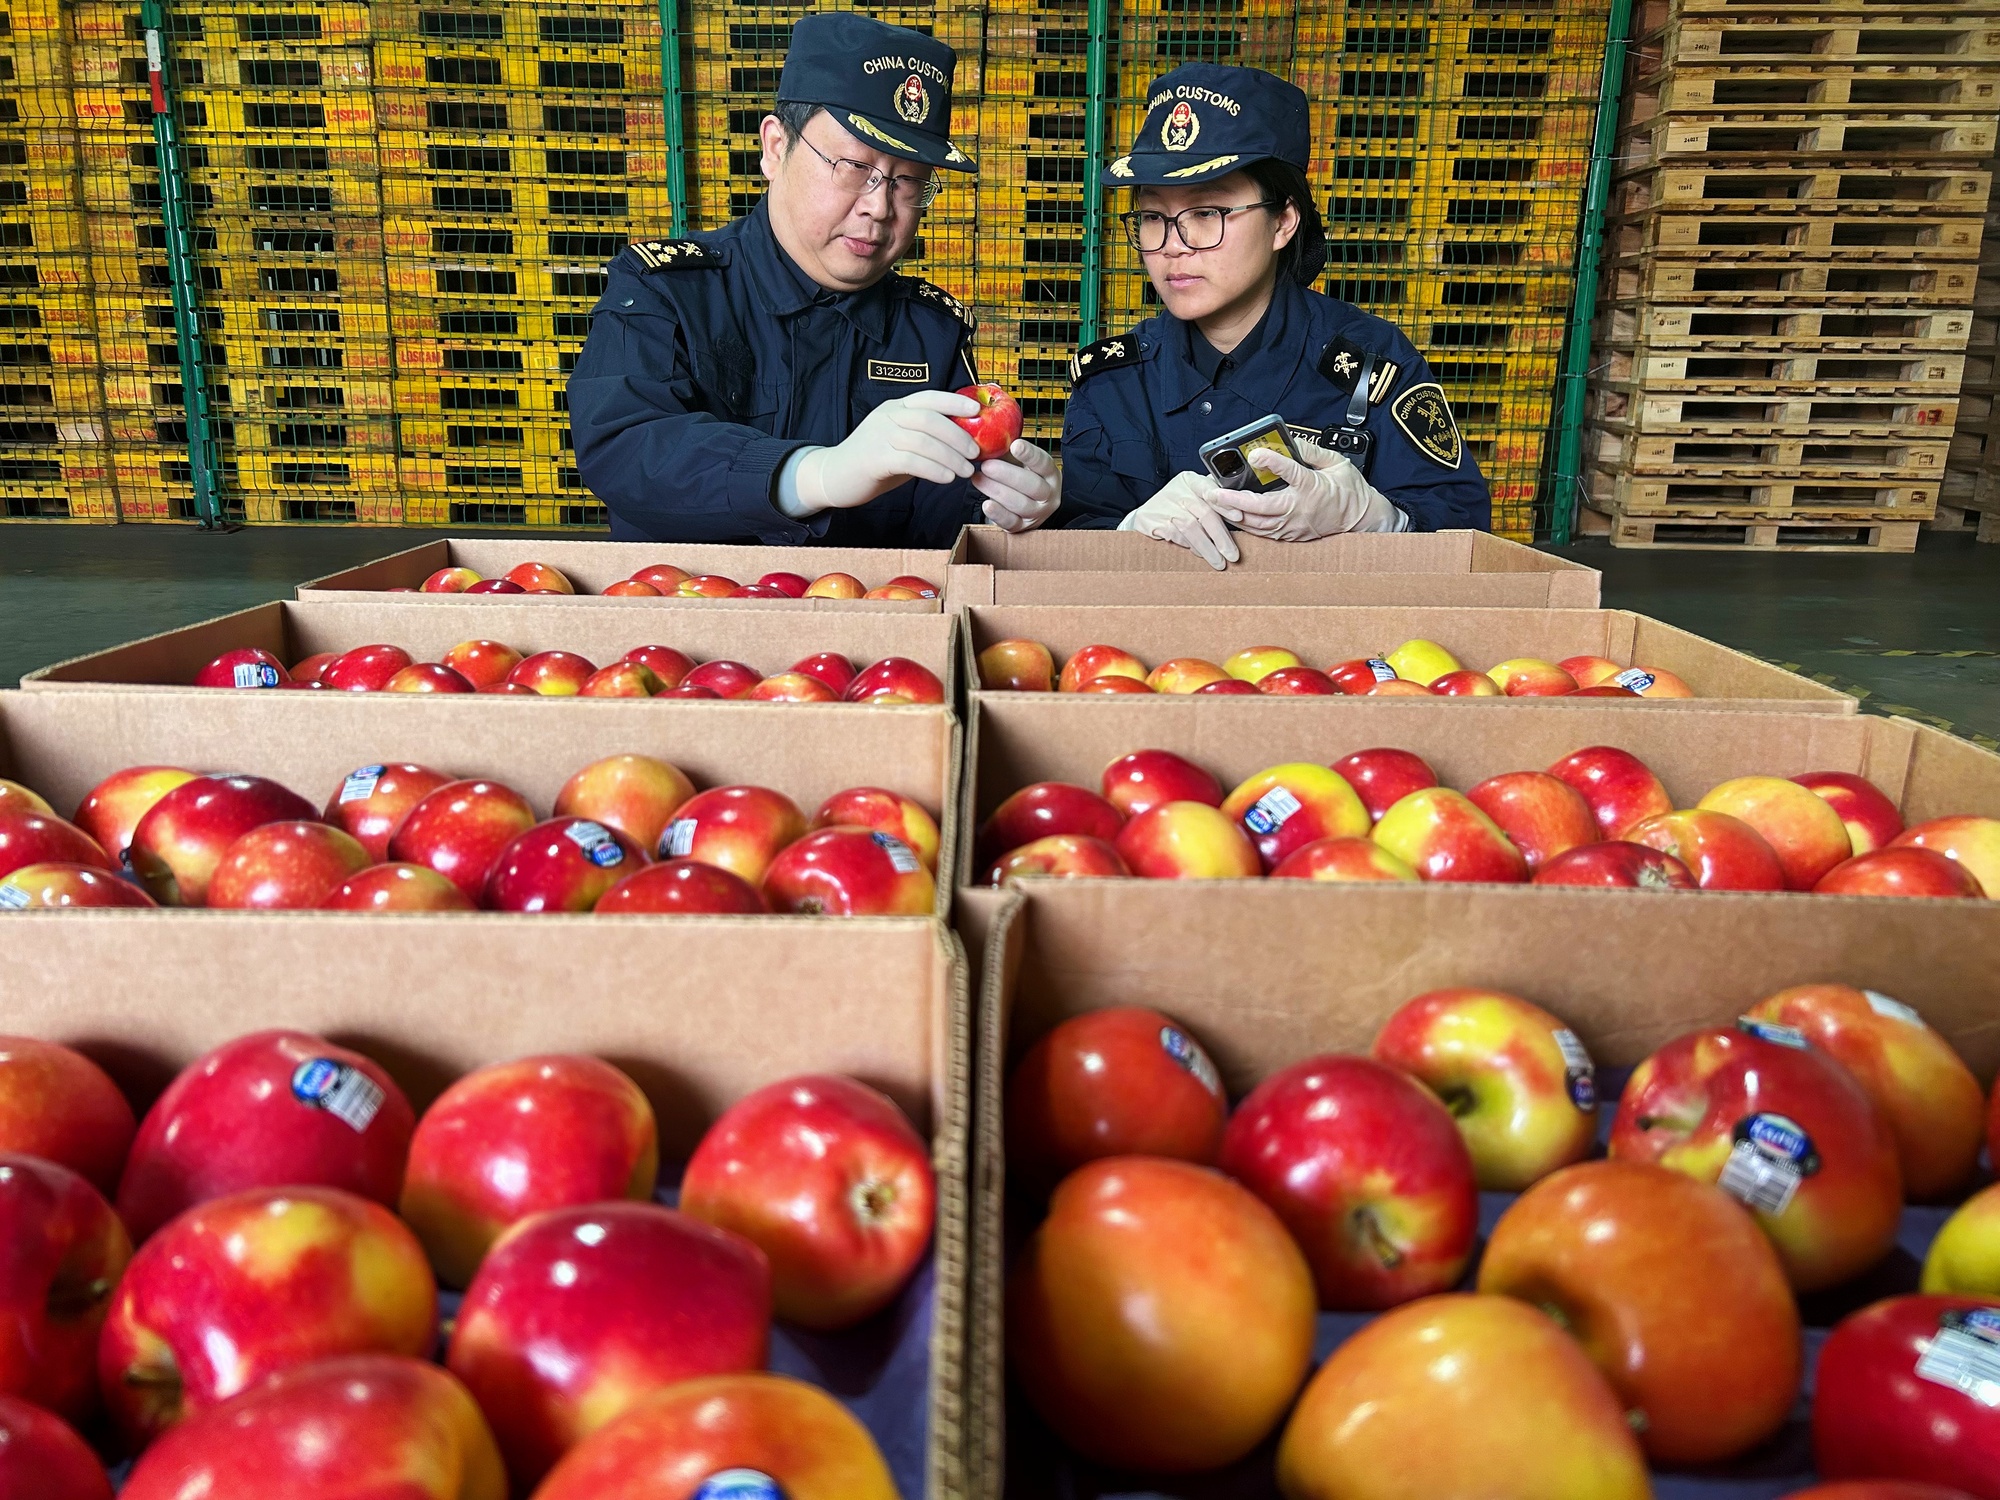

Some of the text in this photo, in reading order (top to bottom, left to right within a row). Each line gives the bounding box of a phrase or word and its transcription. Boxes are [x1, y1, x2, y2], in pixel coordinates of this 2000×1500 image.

[863, 56, 905, 74] CHINA
[1176, 85, 1241, 117] CUSTOMS
[77, 104, 122, 117] LOSCAM
[326, 109, 370, 122] LOSCAM
[378, 104, 427, 117] LOSCAM
[626, 112, 664, 126] LOSCA
[401, 350, 441, 363] LOSCAM
[875, 366, 923, 378] 3122600
[106, 387, 148, 399] LOSCAM
[1400, 397, 1418, 420] CHINA
[404, 434, 444, 446] LOSCAM
[1492, 486, 1534, 498] LOSCAM
[121, 502, 168, 514] LOSCAM
